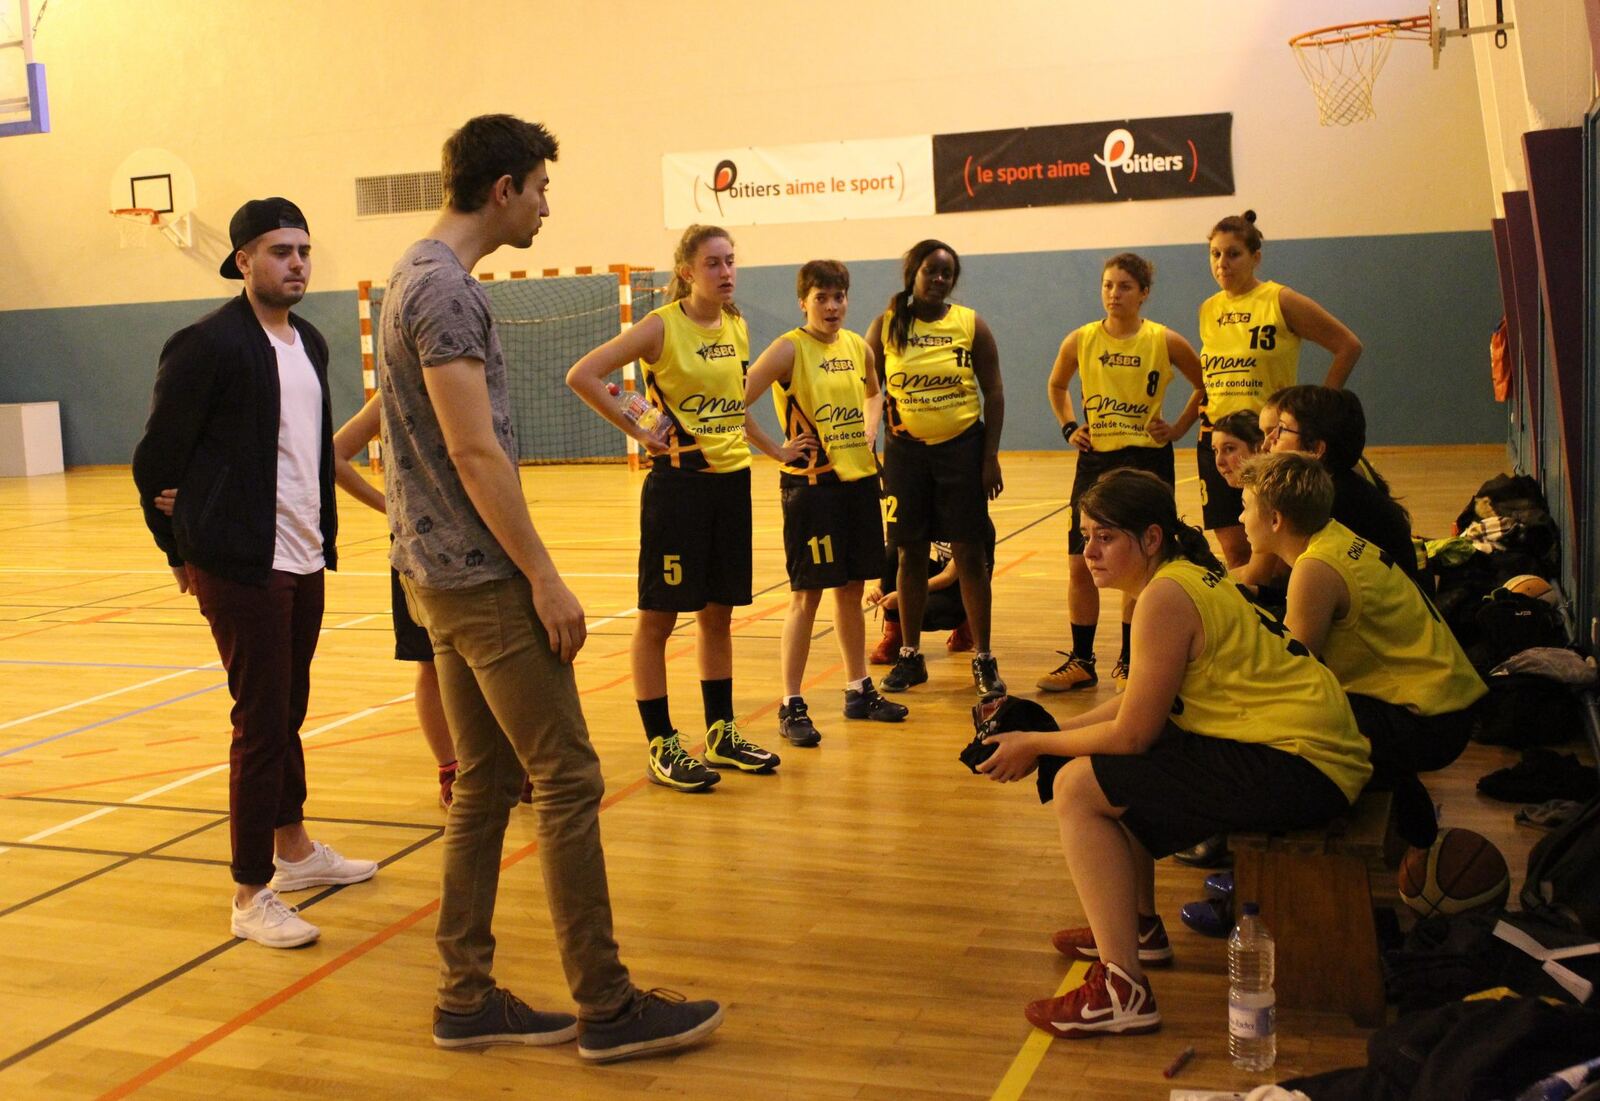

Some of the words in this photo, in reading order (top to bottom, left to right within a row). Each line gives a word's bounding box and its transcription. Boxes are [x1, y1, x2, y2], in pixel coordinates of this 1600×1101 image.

[996, 162, 1044, 185] sport
[1047, 159, 1091, 178] aime
[1093, 127, 1184, 194] Poitiers
[703, 159, 781, 217] Poitiers
[785, 179, 826, 196] aime
[830, 176, 846, 193] le
[1248, 324, 1277, 351] 13
[1108, 355, 1140, 368] ASBC
[1201, 353, 1257, 371] Manu
[888, 371, 963, 390] Manu
[1146, 370, 1160, 398] 8
[1226, 378, 1264, 388] conduite
[1085, 394, 1149, 414] Manu
[715, 423, 727, 434] de
[807, 534, 834, 565] 11
[663, 554, 684, 586] 5
